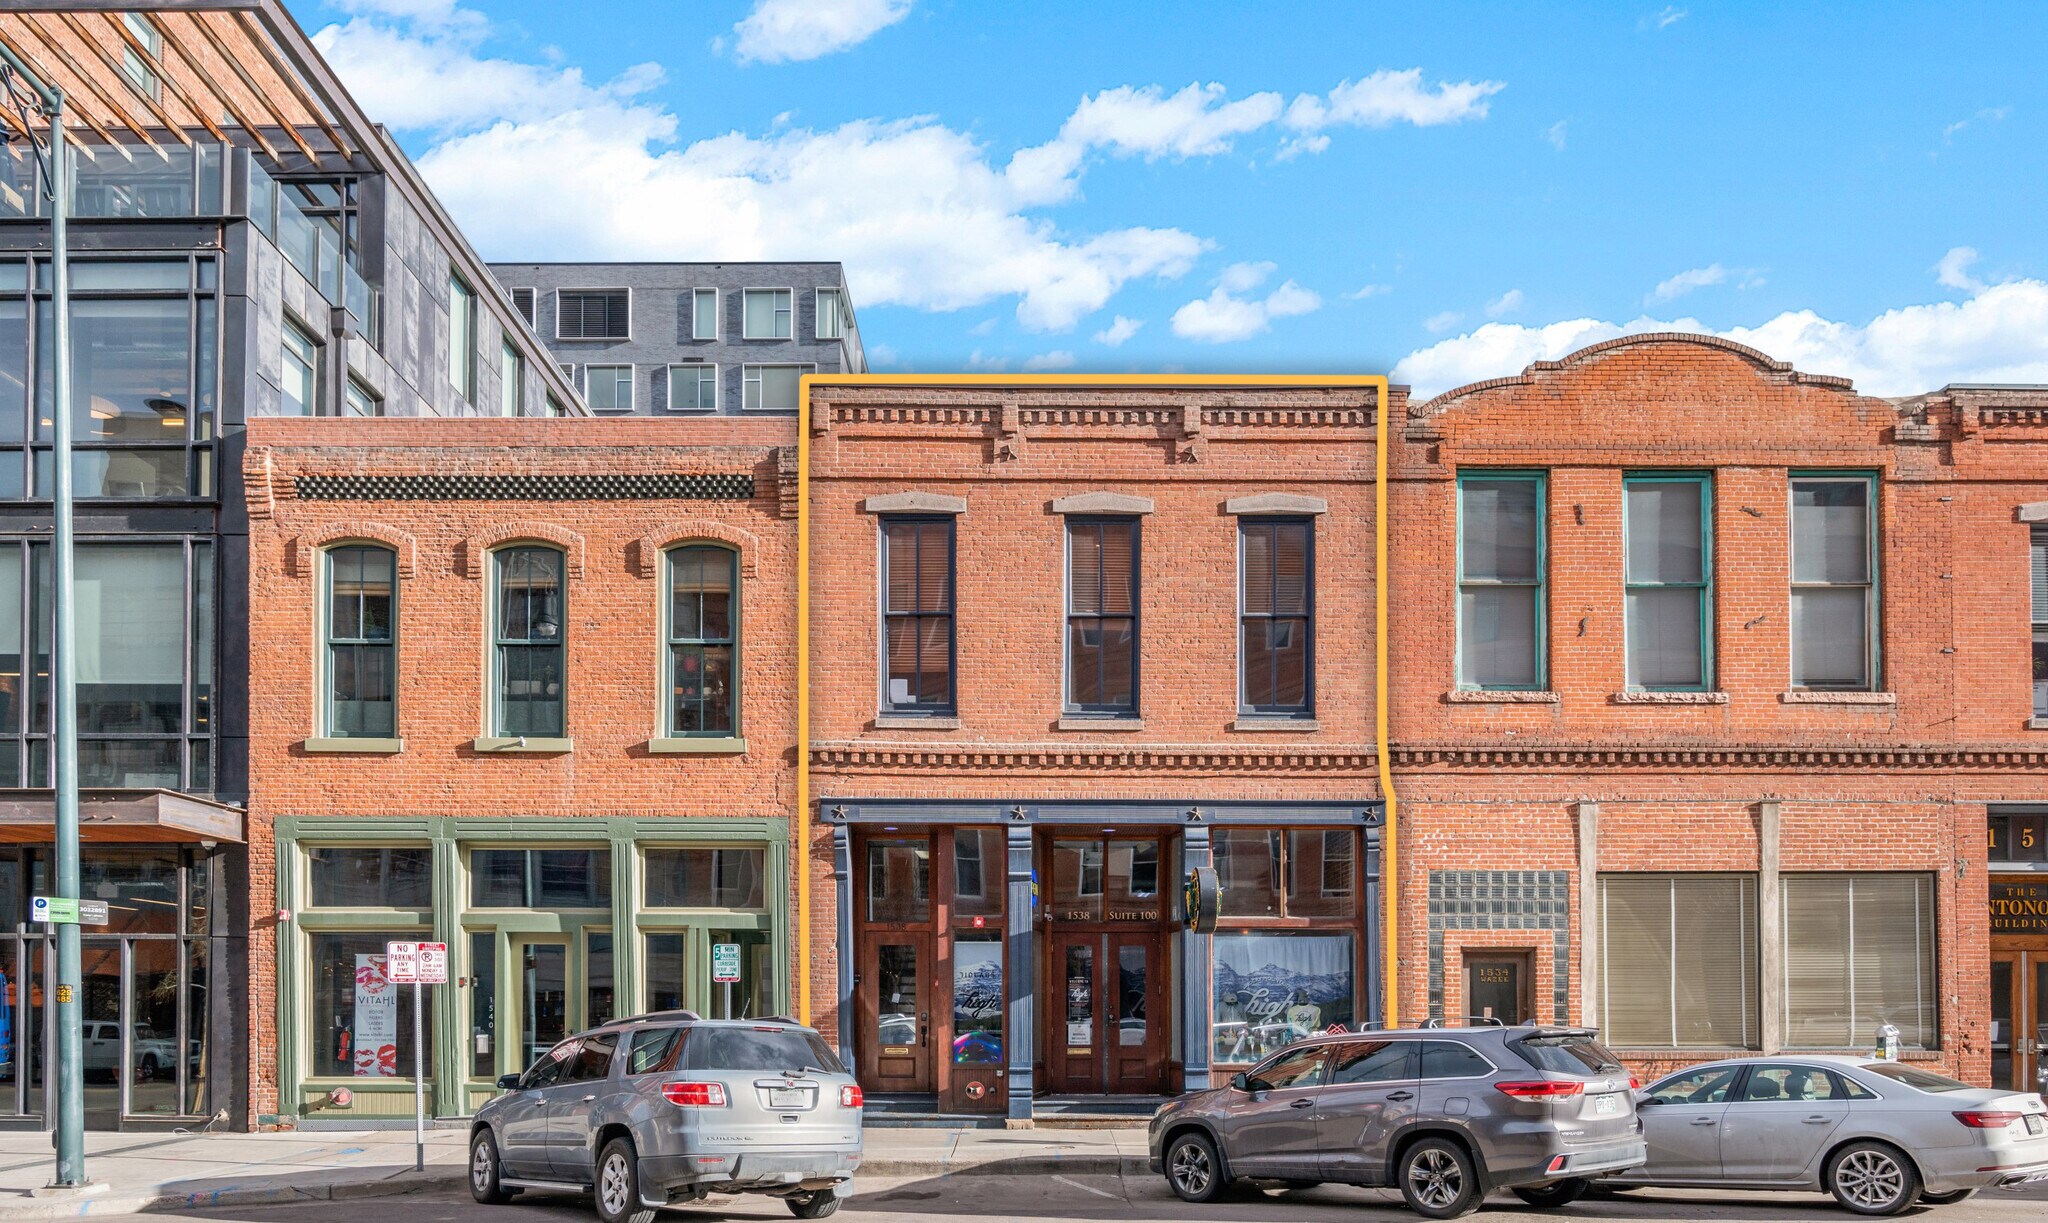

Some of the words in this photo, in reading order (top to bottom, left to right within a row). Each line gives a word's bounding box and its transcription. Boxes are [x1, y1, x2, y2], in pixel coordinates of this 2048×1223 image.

[2021, 828, 2034, 848] 5
[2006, 887, 2037, 897] THE
[1068, 911, 1090, 920] 1538
[1109, 911, 1137, 920] SUITE
[1140, 911, 1157, 920] 100
[1989, 918, 2048, 928] UILDIN
[397, 944, 408, 952] NO
[390, 953, 416, 961] PARKING
[1480, 968, 1509, 976] 1534
[358, 996, 396, 1007] VITAHL
[958, 991, 997, 1019] high
